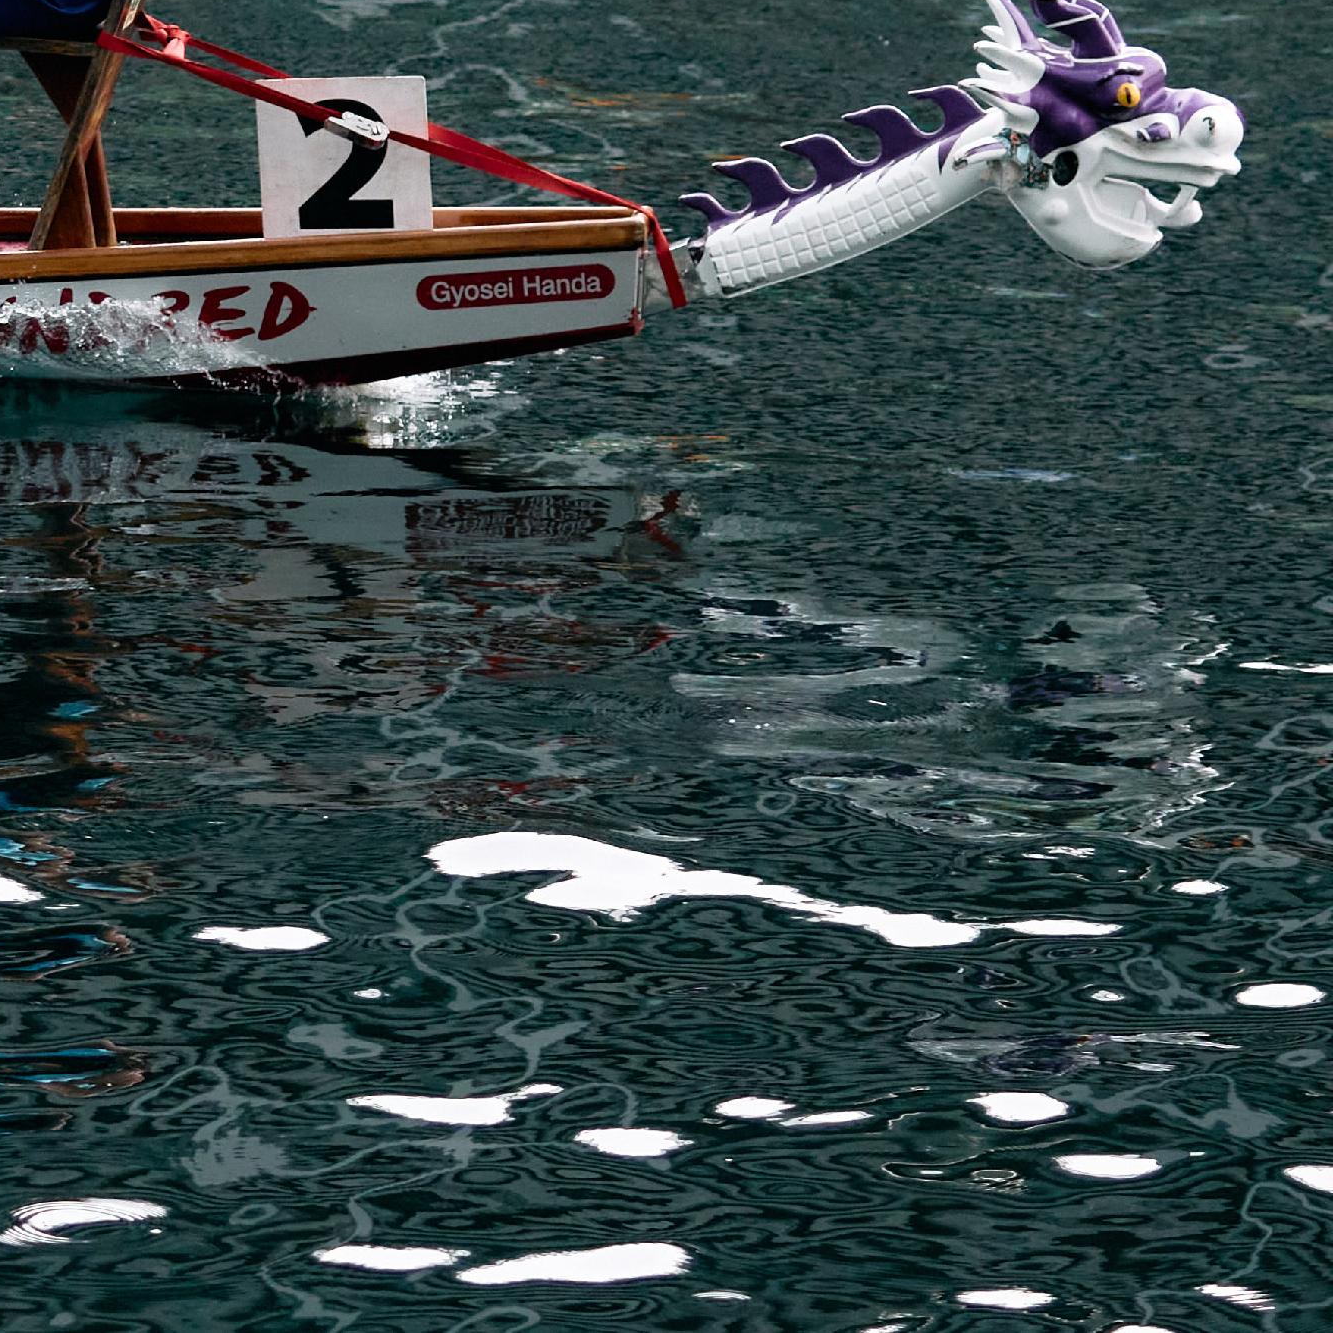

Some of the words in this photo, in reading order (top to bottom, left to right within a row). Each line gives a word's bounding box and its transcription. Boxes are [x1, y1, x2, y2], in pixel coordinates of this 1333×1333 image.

[295, 98, 395, 230] 2
[430, 277, 514, 308] Gyosei
[522, 272, 603, 297] Handa
